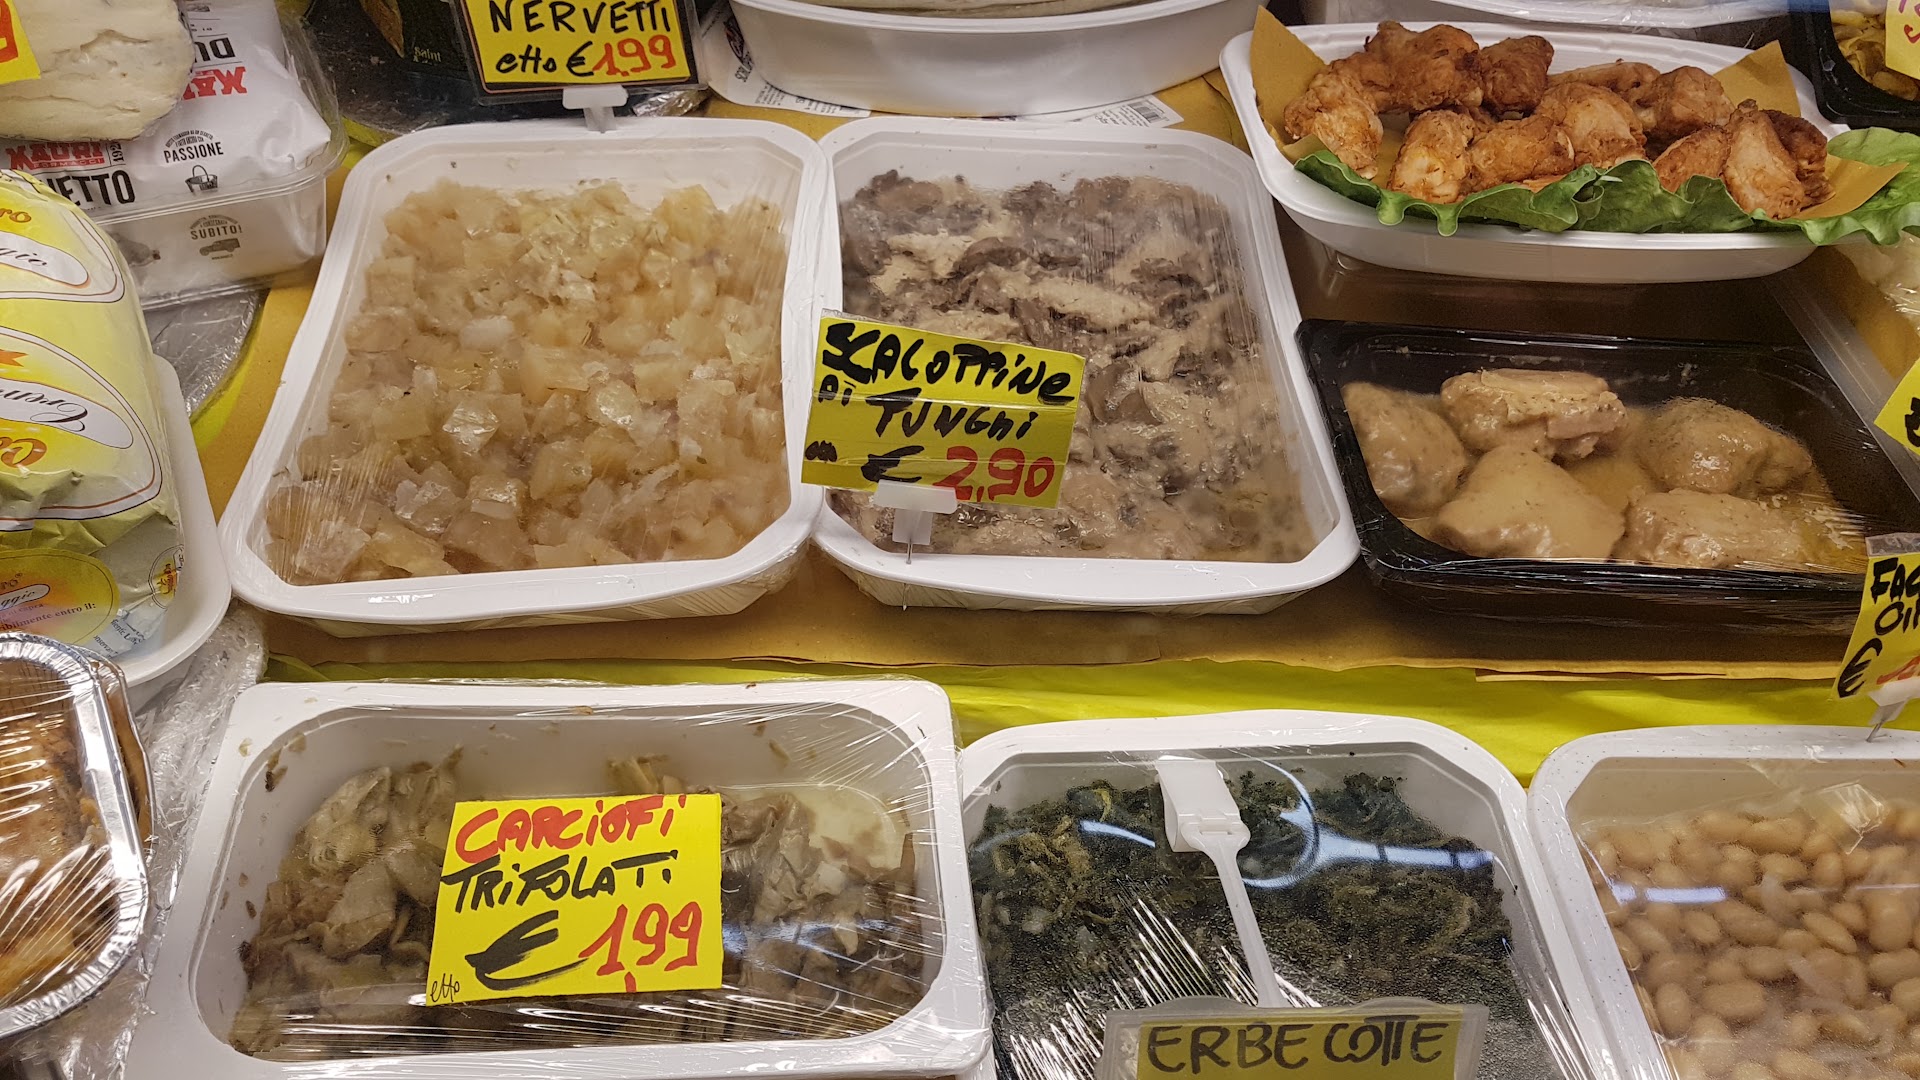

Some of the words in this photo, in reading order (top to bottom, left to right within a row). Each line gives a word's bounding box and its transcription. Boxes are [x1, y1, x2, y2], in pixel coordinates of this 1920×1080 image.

[488, 0, 671, 33] NERVETTI
[495, 44, 557, 74] etto
[163, 141, 224, 164] PASSIONE
[190, 224, 243, 240] SUBITO!
[54, 606, 83, 618] entro
[1147, 1020, 1314, 1075] ERBE
[1323, 1014, 1450, 1068] COTTE
